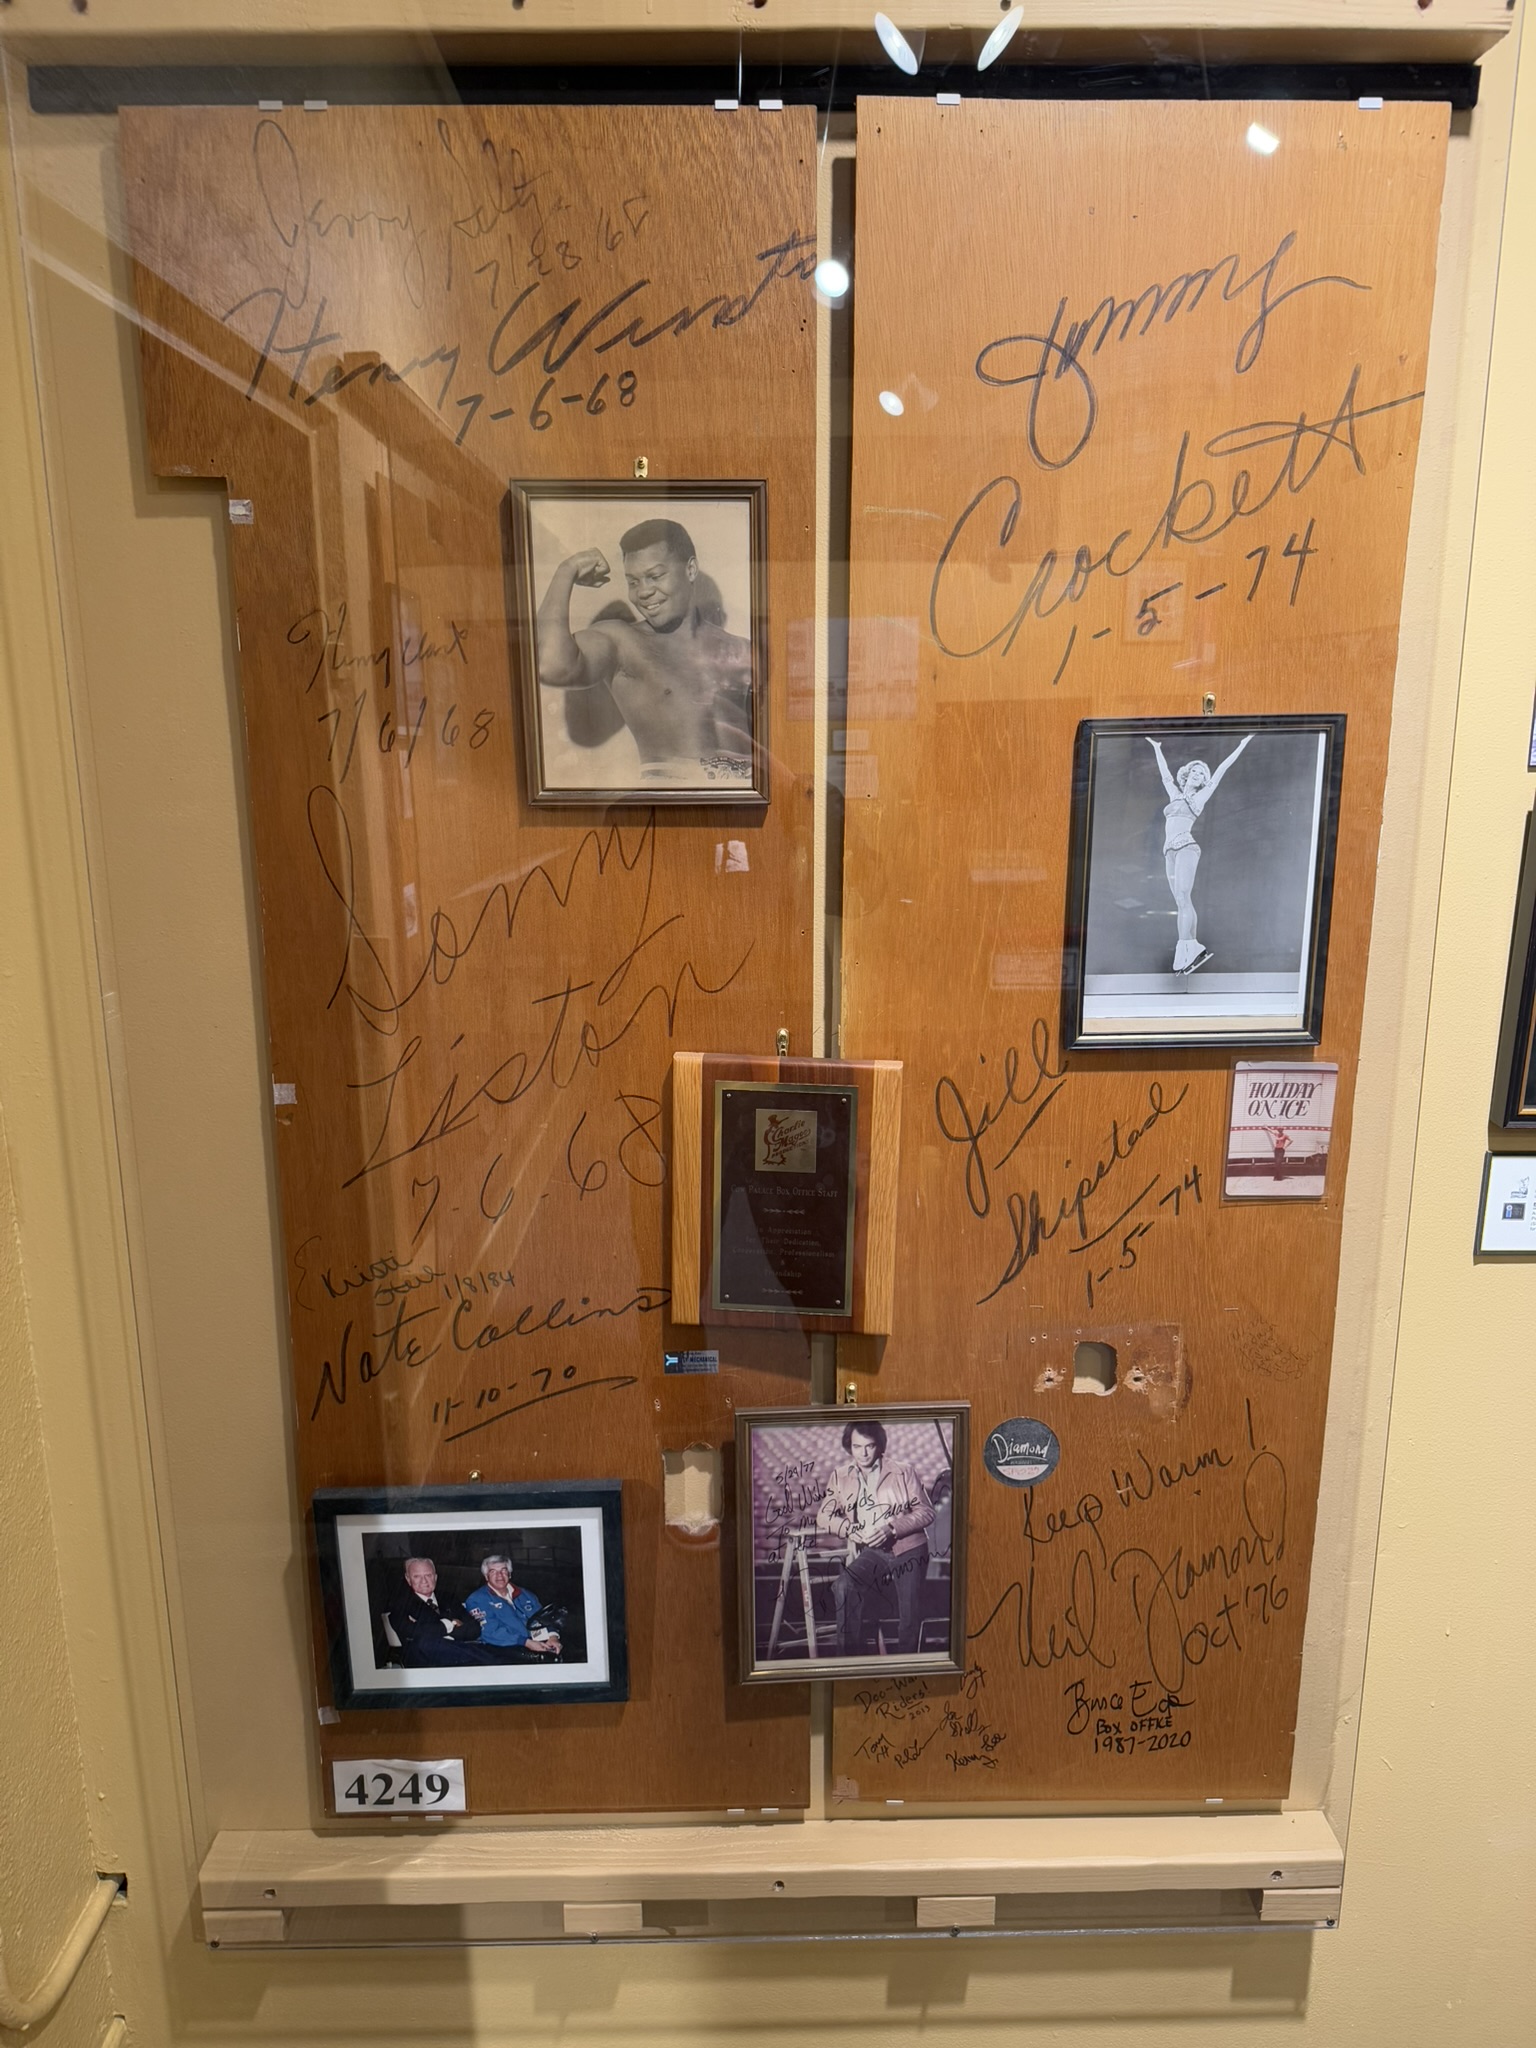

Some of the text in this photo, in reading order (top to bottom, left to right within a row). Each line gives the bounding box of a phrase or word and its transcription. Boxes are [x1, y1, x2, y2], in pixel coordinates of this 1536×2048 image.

[221, 287, 459, 410] Henry
[456, 370, 638, 447] 7-6-68
[930, 363, 1425, 658] Crockett
[1053, 518, 1318, 685] 1-5-74
[317, 688, 495, 785] 7/6/68
[307, 785, 684, 1036] Sonny
[343, 939, 755, 1189] Liston
[1248, 1082, 1322, 1099] HOLIDAY
[772, 1119, 806, 1142] Charlie
[935, 1018, 1069, 1219] Jill
[1248, 1099, 1311, 1119] ON ICE
[767, 1226, 812, 1236] Appreciation
[976, 1081, 1189, 1305] Shipstad
[1084, 1164, 1204, 1309] 1-5-74
[444, 1270, 516, 1301] 1/8/84
[311, 1286, 672, 1422] Nate Collins
[991, 1433, 1053, 1464] Diamond
[1022, 1486, 1107, 1570] Keep
[1094, 1730, 1192, 1755] 1987-2020
[1096, 1716, 1173, 1736] BOX OFFICE
[344, 1772, 451, 1806] 4249
